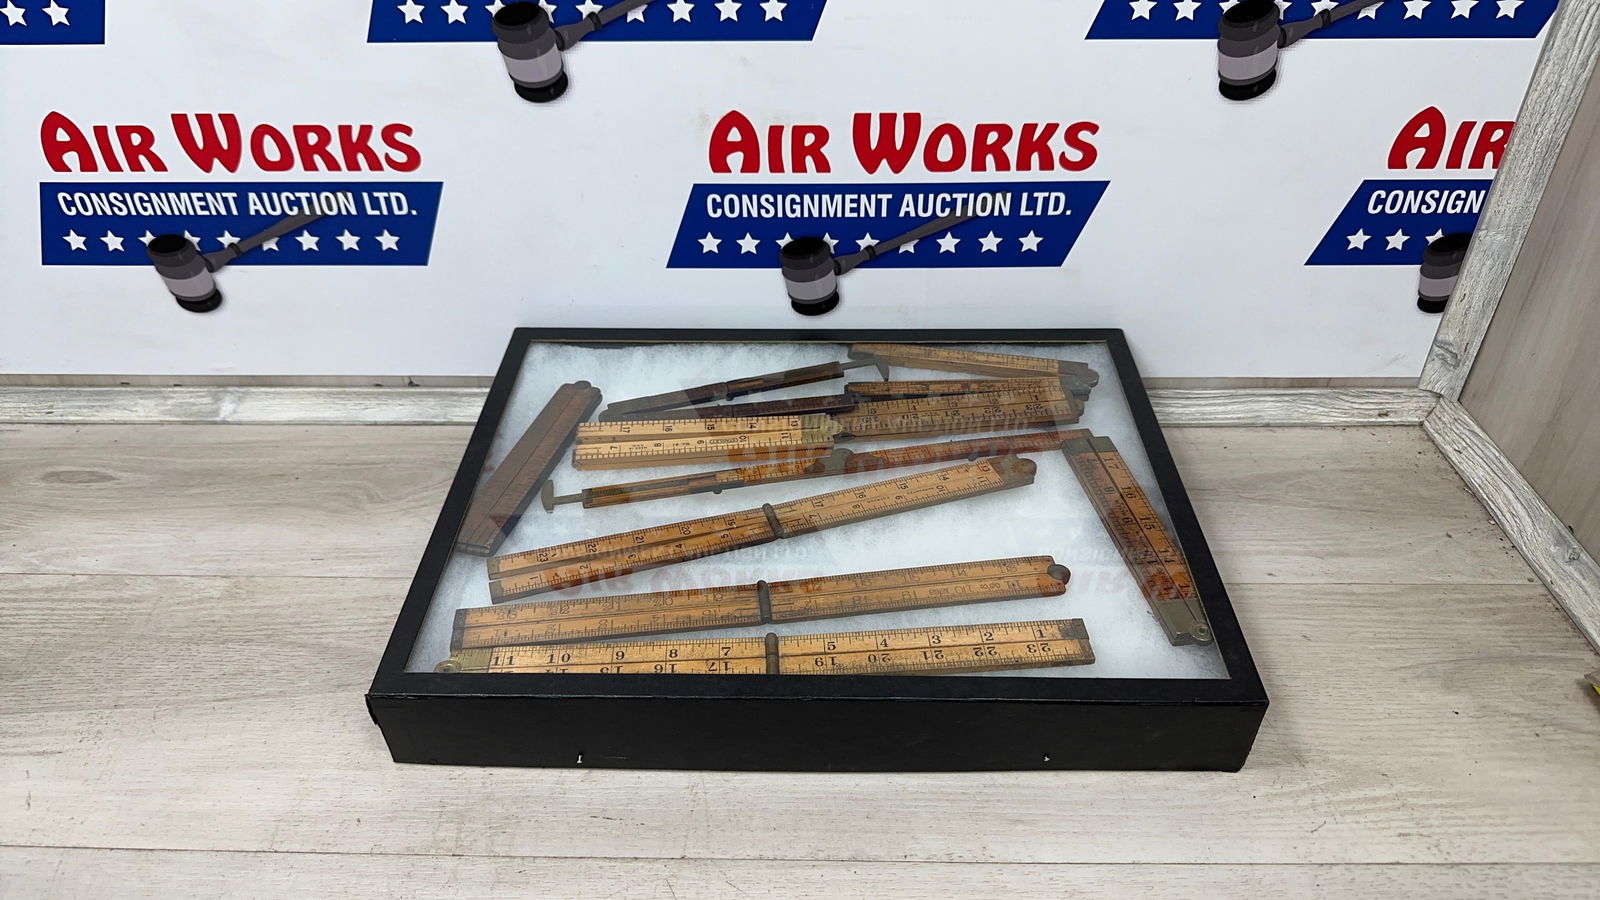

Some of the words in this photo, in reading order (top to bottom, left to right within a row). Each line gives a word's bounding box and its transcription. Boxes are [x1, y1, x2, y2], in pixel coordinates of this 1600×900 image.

[40, 111, 168, 173] AIR
[171, 112, 422, 174] WORKS
[708, 110, 832, 174] AIR
[852, 111, 1100, 175] WORKS
[1387, 105, 1515, 170] AIR
[57, 191, 238, 217] CONSIGNMENT
[249, 191, 357, 217] AUCTION
[365, 191, 418, 217] LTD.
[706, 193, 892, 219] CONSIGNMENT
[898, 192, 1011, 218] AUCTION
[1019, 192, 1072, 217] LTD.
[1367, 189, 1486, 215] CONSIGN
[621, 425, 631, 434] 17
[664, 424, 673, 433] 16
[706, 423, 715, 431] 15
[748, 421, 757, 430] 14
[790, 419, 799, 428] 13
[814, 498, 825, 509] 17
[857, 489, 868, 500] 16
[899, 481, 909, 491] 15
[941, 471, 951, 482] 14
[980, 463, 990, 473] 13
[1102, 457, 1119, 470] 17
[1121, 485, 1136, 499] 16
[1139, 515, 1156, 531] 15
[1158, 547, 1175, 564] 14
[537, 551, 549, 563] 23
[587, 542, 598, 553] 22
[634, 533, 645, 545] 21
[681, 525, 692, 536] 20
[720, 532, 729, 540] 5
[493, 654, 515, 666] 11
[547, 652, 571, 664] 10
[615, 650, 625, 661] 9
[668, 647, 678, 658] 8
[721, 646, 731, 656] 7
[827, 640, 836, 651] 5
[879, 637, 889, 648] 4
[932, 634, 942, 646] 3
[984, 630, 994, 641] 2
[1036, 628, 1044, 639] 1
[708, 661, 731, 672] 17
[814, 655, 837, 667] 19
[868, 653, 891, 663] 20
[923, 650, 944, 660] 21
[975, 646, 998, 657] 22
[1027, 642, 1052, 653] 23
